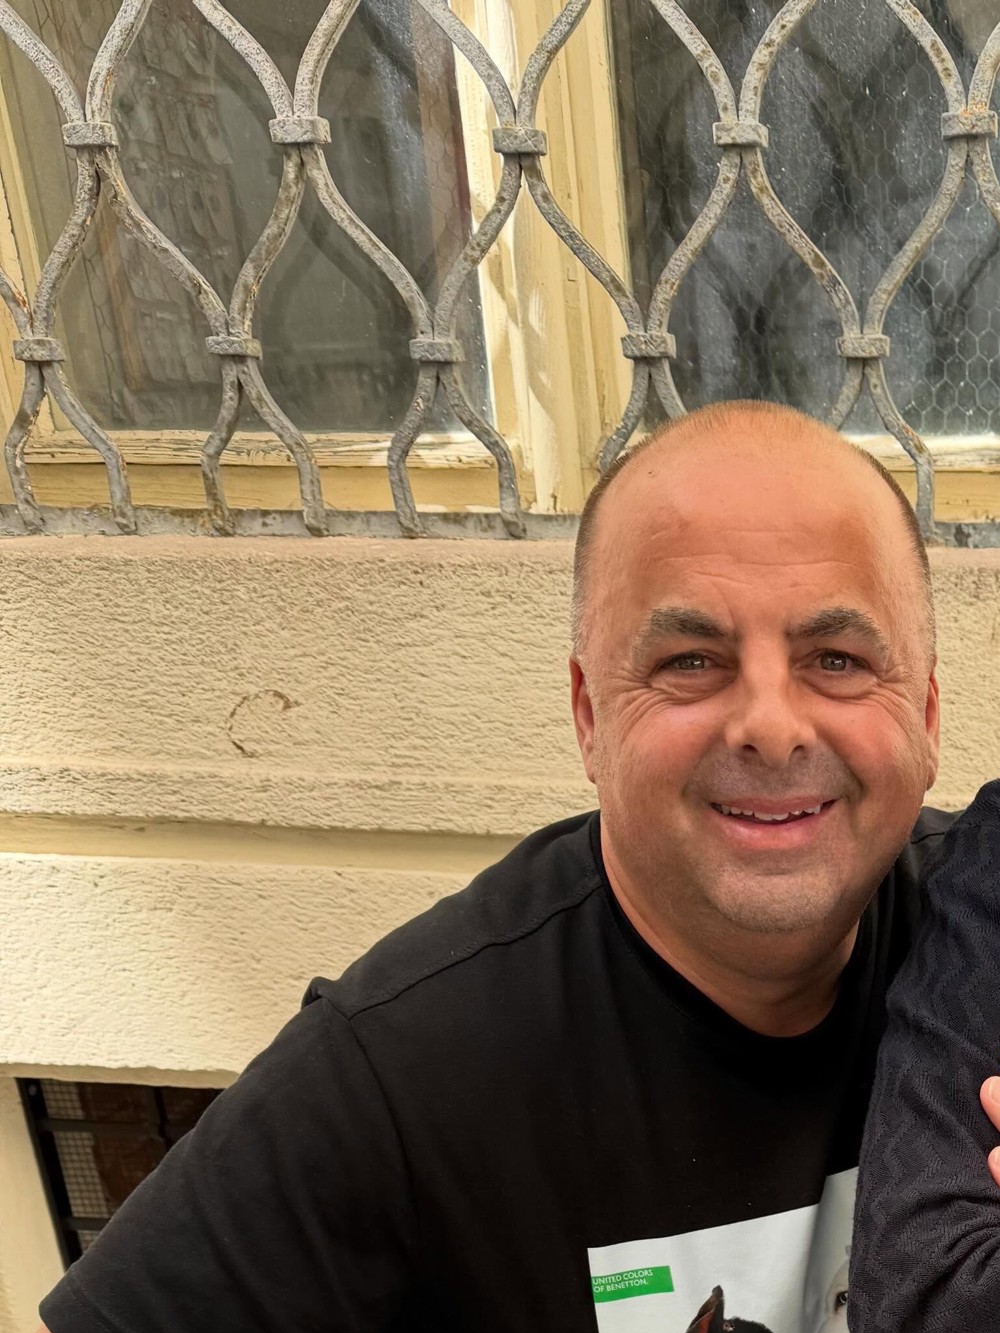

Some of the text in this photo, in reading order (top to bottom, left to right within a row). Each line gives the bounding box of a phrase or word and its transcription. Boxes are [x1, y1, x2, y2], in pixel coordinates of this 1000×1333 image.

[592, 1269, 653, 1285] UNITED COLORS
[593, 1285, 604, 1293] OF
